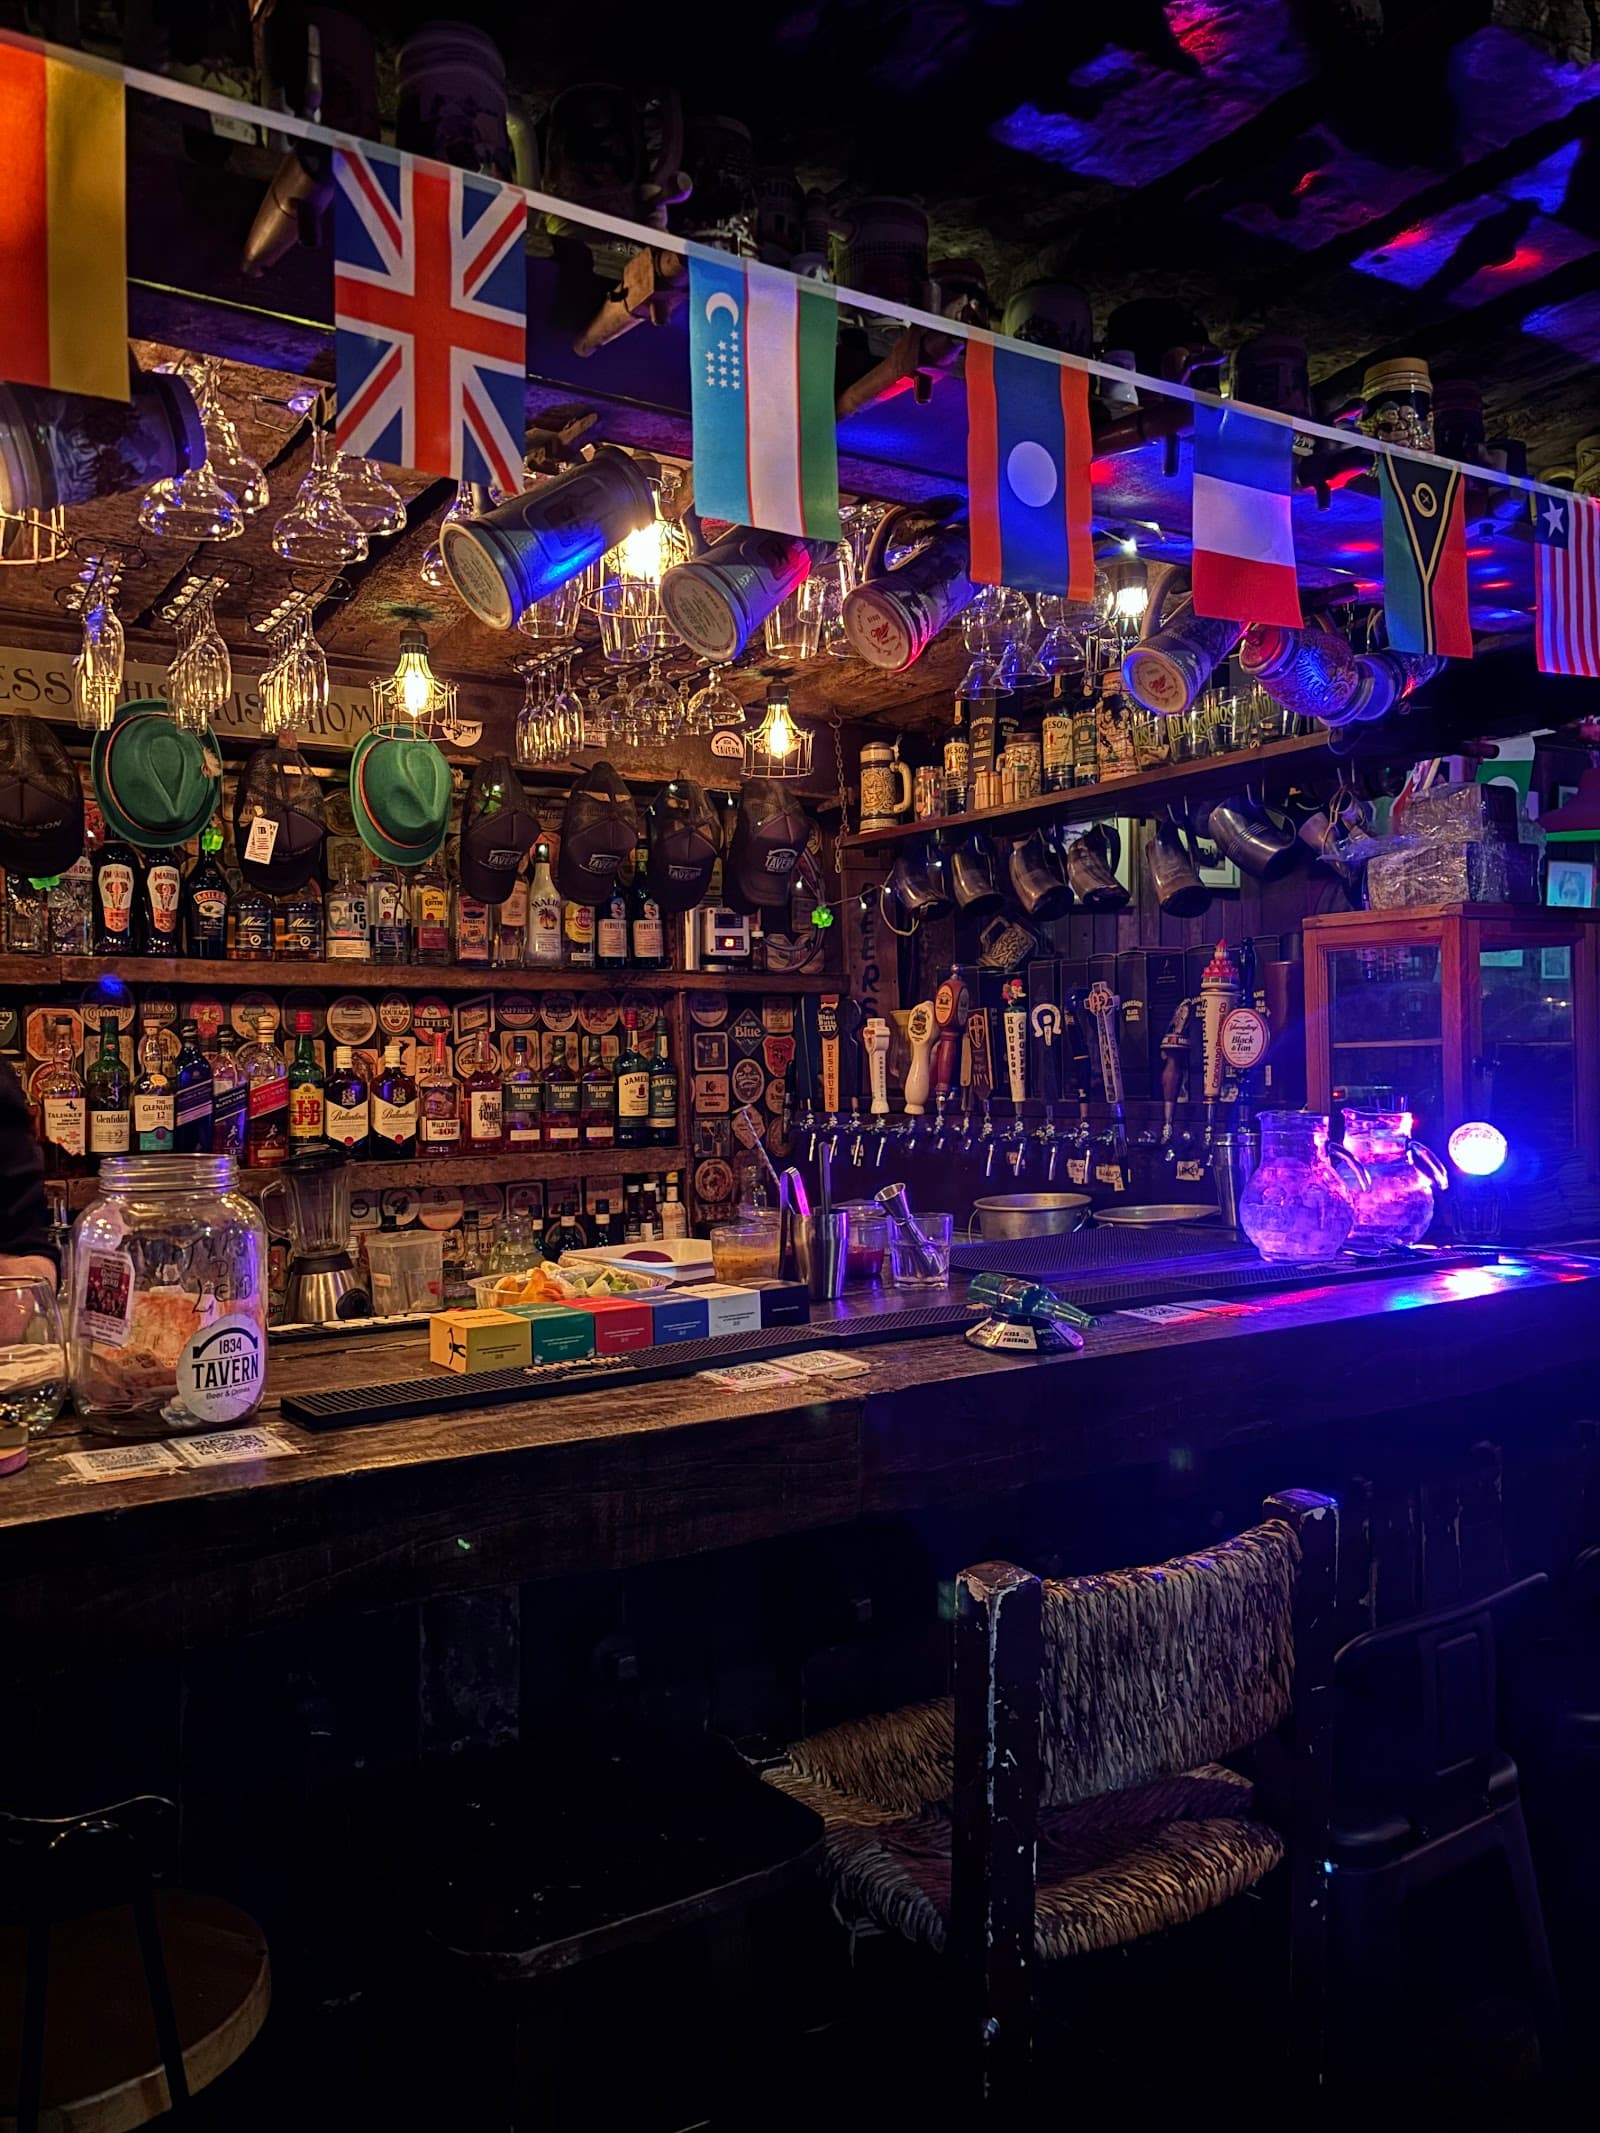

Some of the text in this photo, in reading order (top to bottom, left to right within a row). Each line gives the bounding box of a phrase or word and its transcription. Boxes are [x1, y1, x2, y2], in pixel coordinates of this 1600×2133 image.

[970, 717, 994, 728] JAMESON
[488, 854, 521, 866] TAVERN
[413, 1018, 450, 1028] BITTER
[1228, 1022, 1259, 1033] Yuengling
[734, 1026, 761, 1038] Blue
[1231, 1035, 1254, 1045] Black
[1007, 1016, 1017, 1076] HOUBLON
[1237, 1043, 1252, 1051] Tan
[1211, 1045, 1222, 1089] CORONADO
[623, 1075, 649, 1086] JAMES
[511, 1086, 540, 1094] TULLAMORE
[551, 1085, 578, 1093] TULLAMORE
[157, 1111, 165, 1119] 12
[218, 1335, 242, 1356] 1834
[192, 1351, 259, 1390] TAVERN
[206, 1388, 223, 1400] Beer
